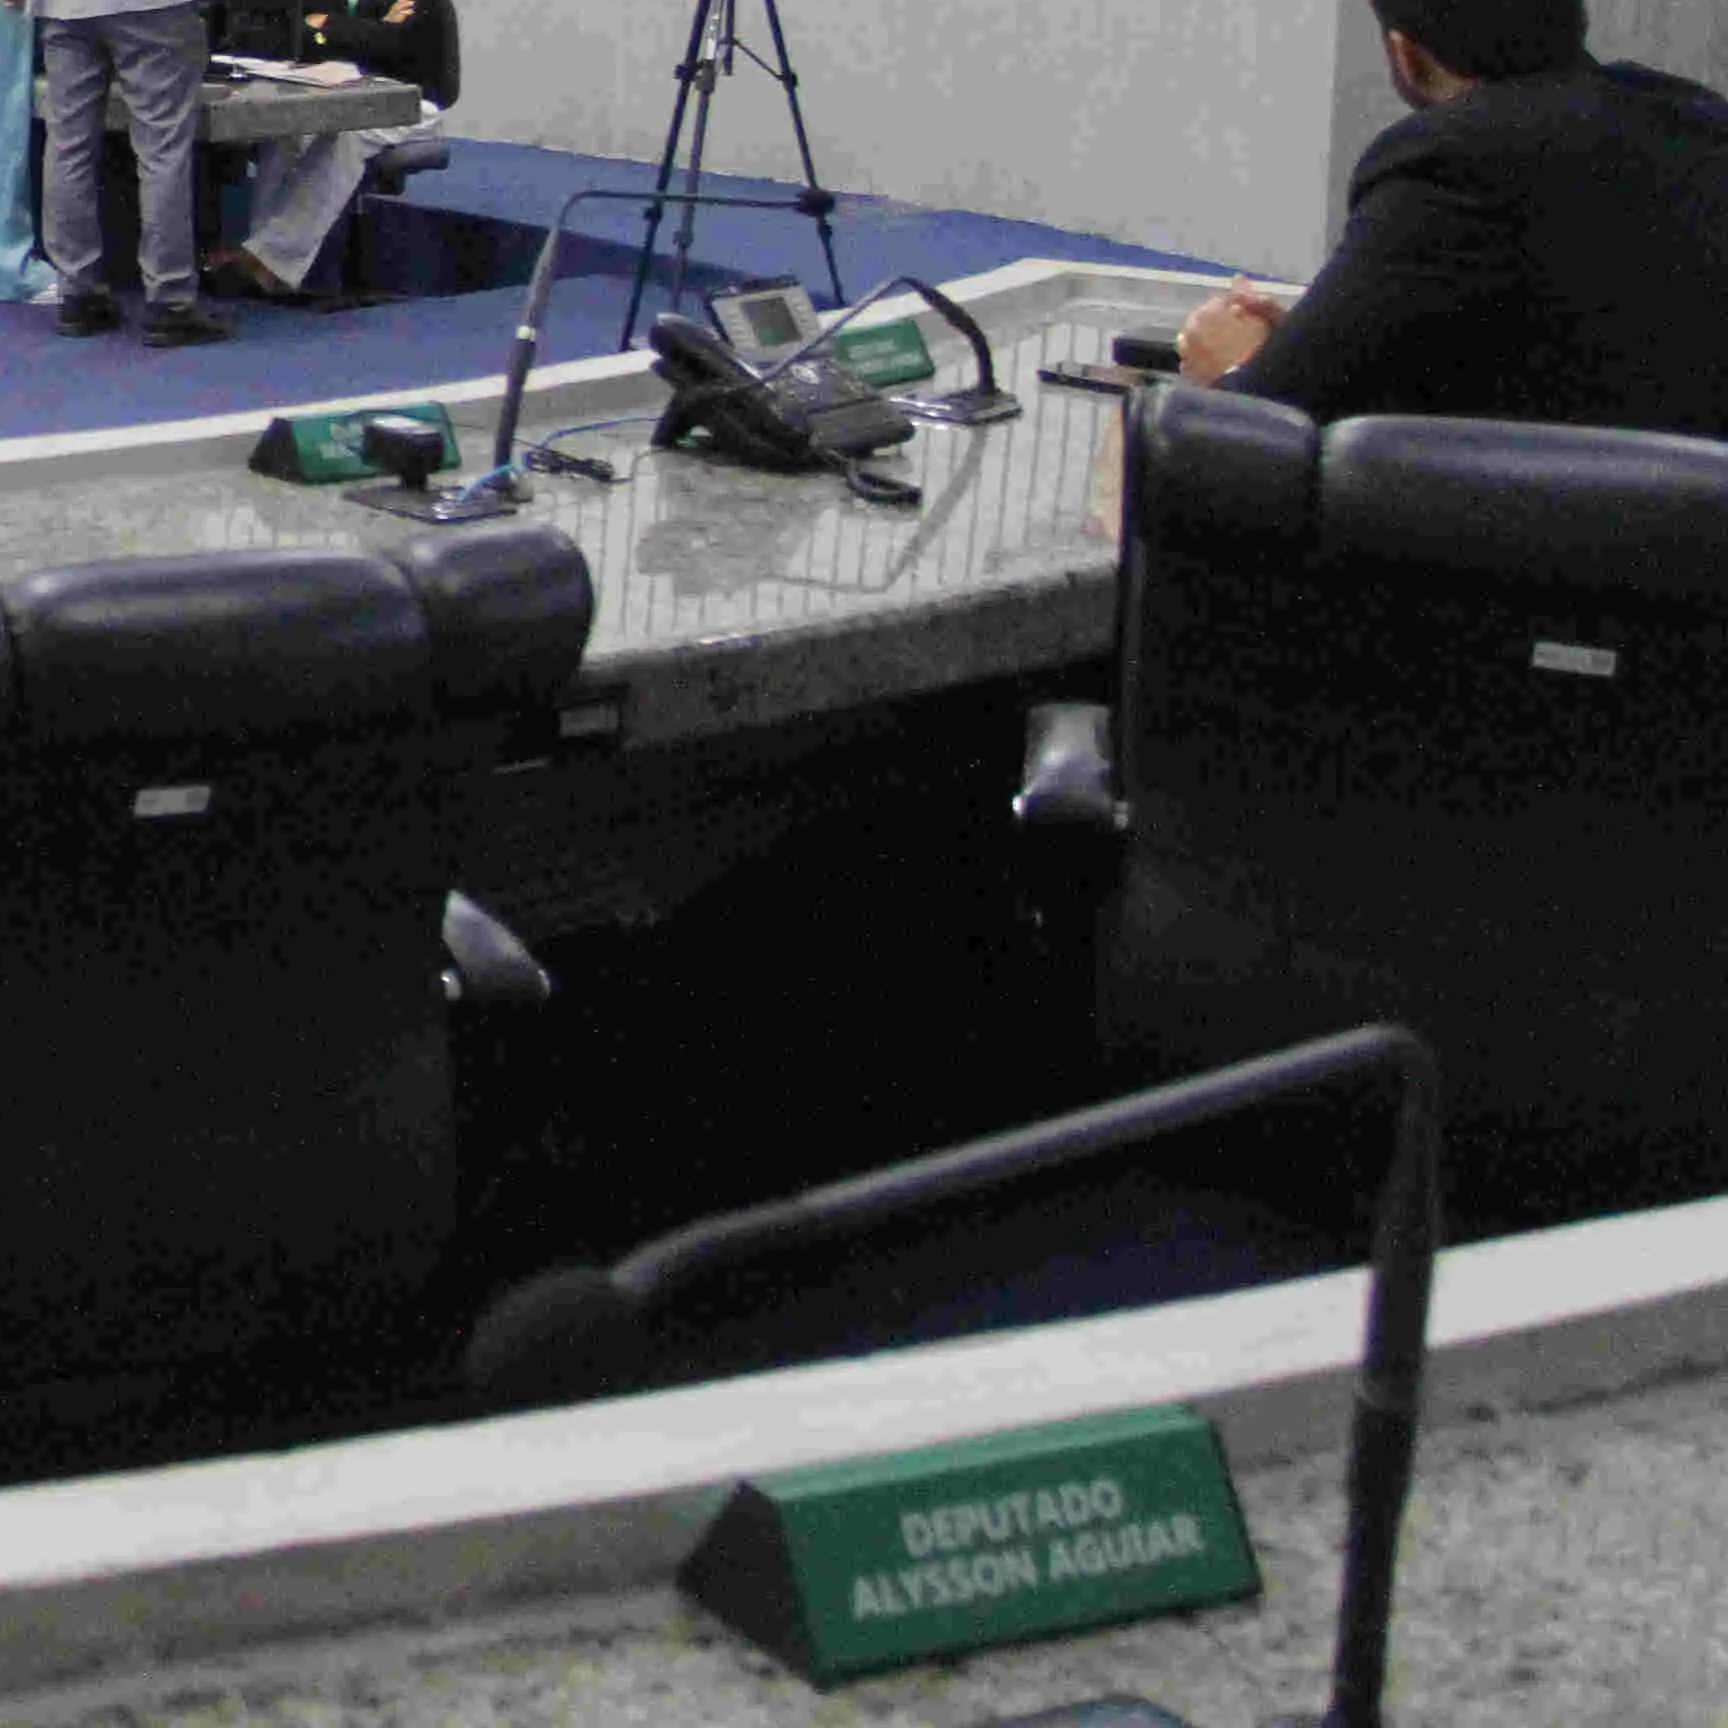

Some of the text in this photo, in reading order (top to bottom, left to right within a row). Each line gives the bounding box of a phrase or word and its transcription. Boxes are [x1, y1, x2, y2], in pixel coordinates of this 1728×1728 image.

[853, 1512, 1206, 1621] ALYSSON AGUIAR
[901, 1479, 1122, 1560] DEPUTADO
